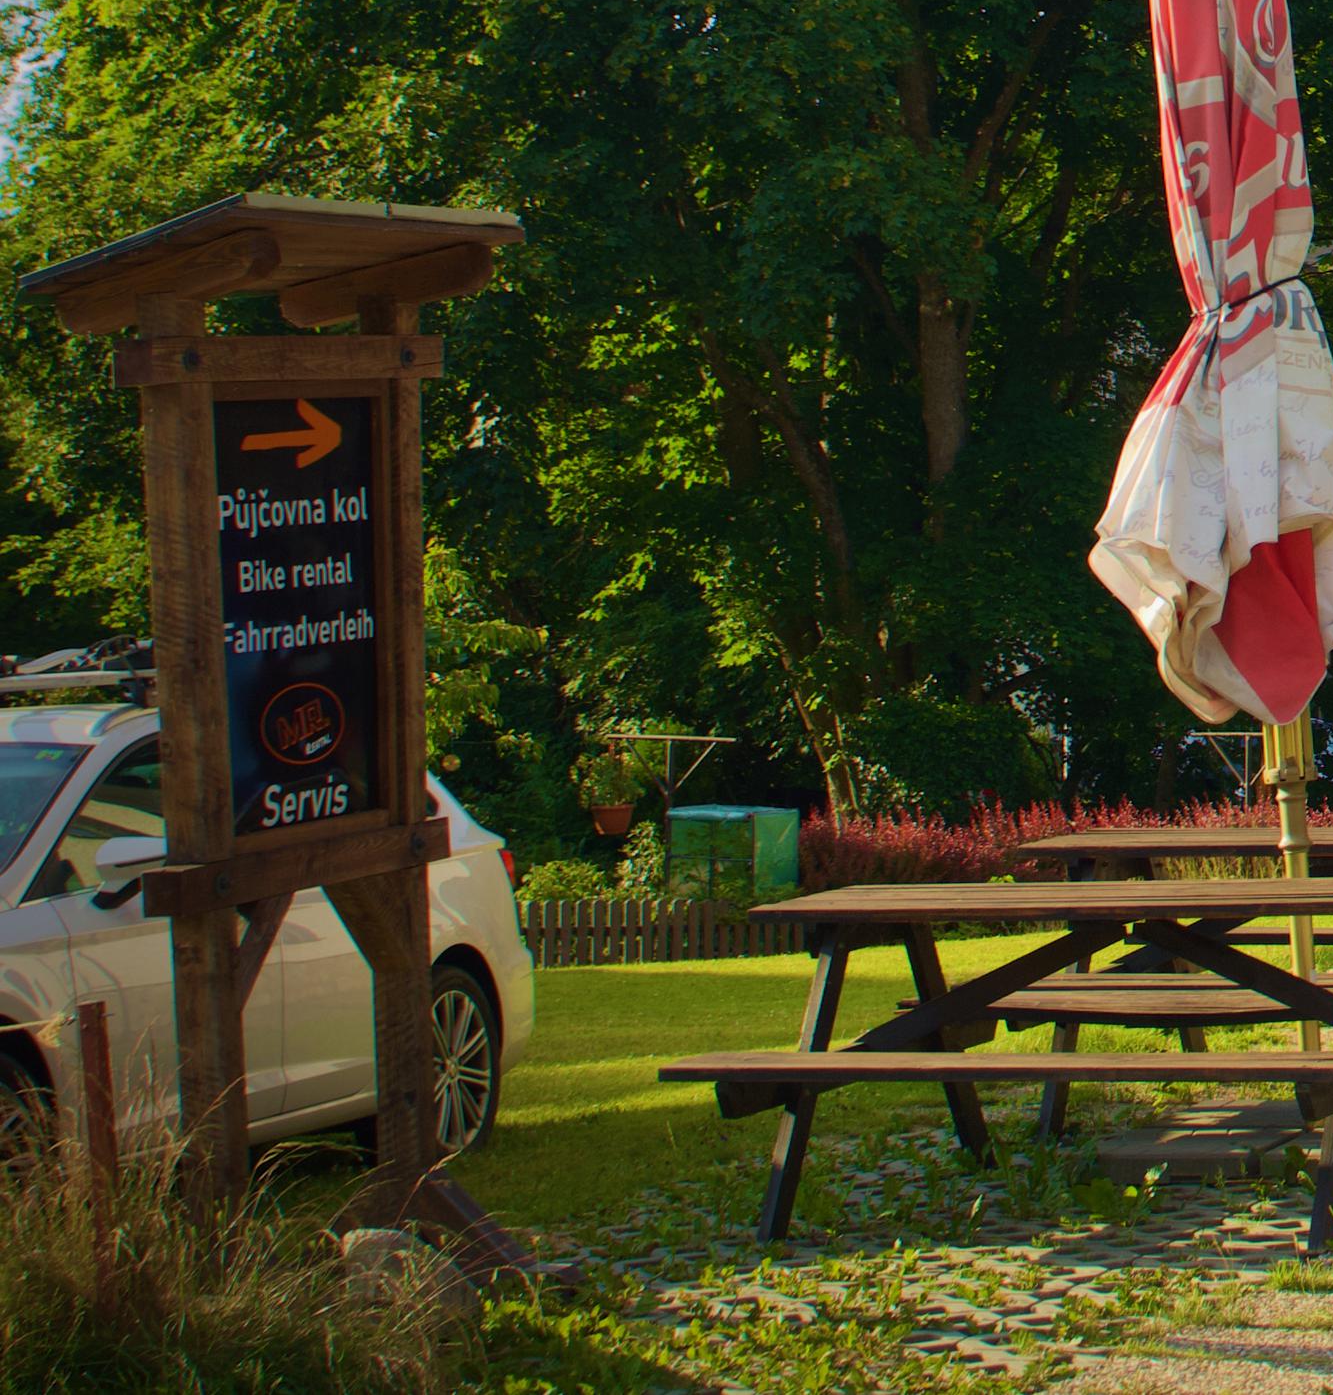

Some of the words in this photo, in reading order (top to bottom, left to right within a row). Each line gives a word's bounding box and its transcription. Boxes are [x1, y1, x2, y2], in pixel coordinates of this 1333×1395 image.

[219, 488, 327, 539] Půjčovna
[333, 486, 369, 523] kol
[238, 559, 286, 593] Bike
[291, 553, 353, 590] rental
[261, 775, 349, 828] Servis
